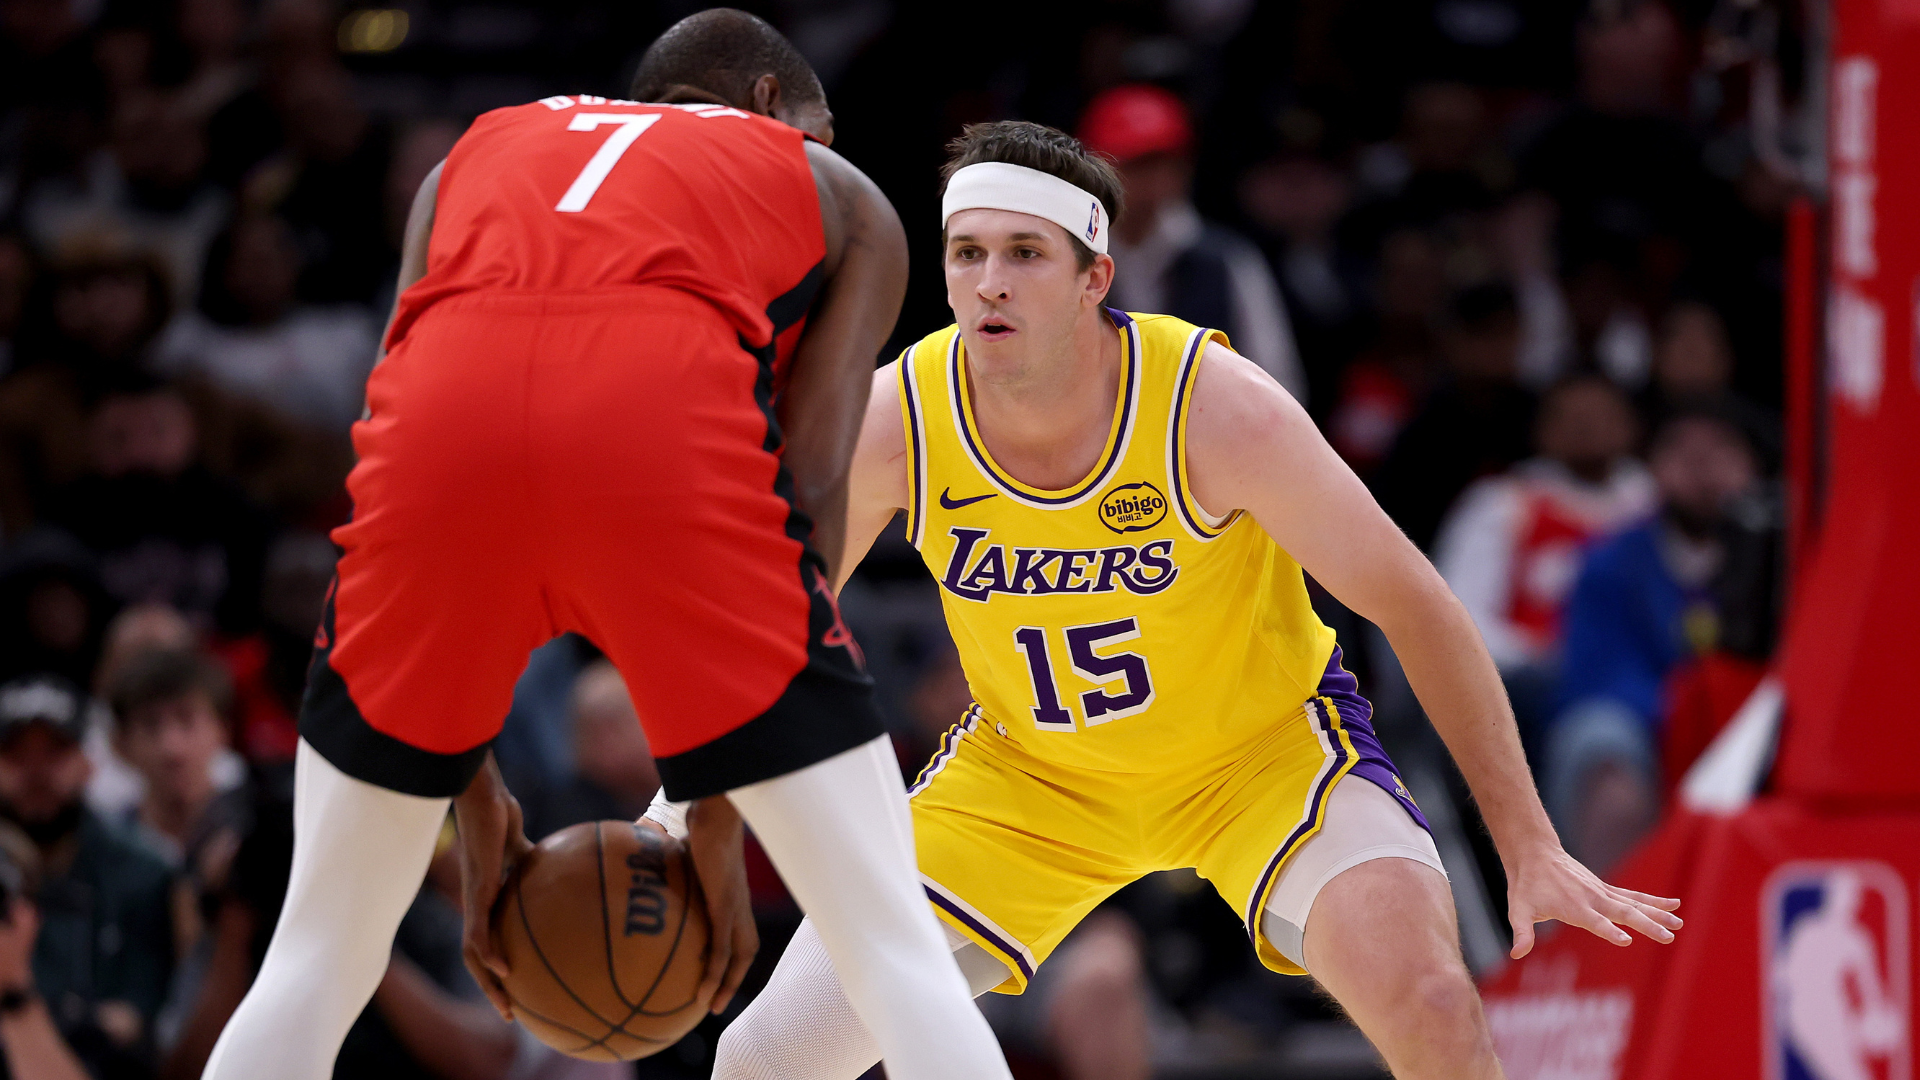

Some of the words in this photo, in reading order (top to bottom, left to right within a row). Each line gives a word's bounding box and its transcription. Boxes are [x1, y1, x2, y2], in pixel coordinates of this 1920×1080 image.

[538, 94, 750, 119] DUT
[554, 113, 663, 212] 7
[1103, 495, 1163, 518] bibigo
[1117, 512, 1143, 523] 비비고
[940, 525, 1181, 604] LAKERS
[1012, 615, 1157, 733] 15
[624, 828, 667, 938] Wil
